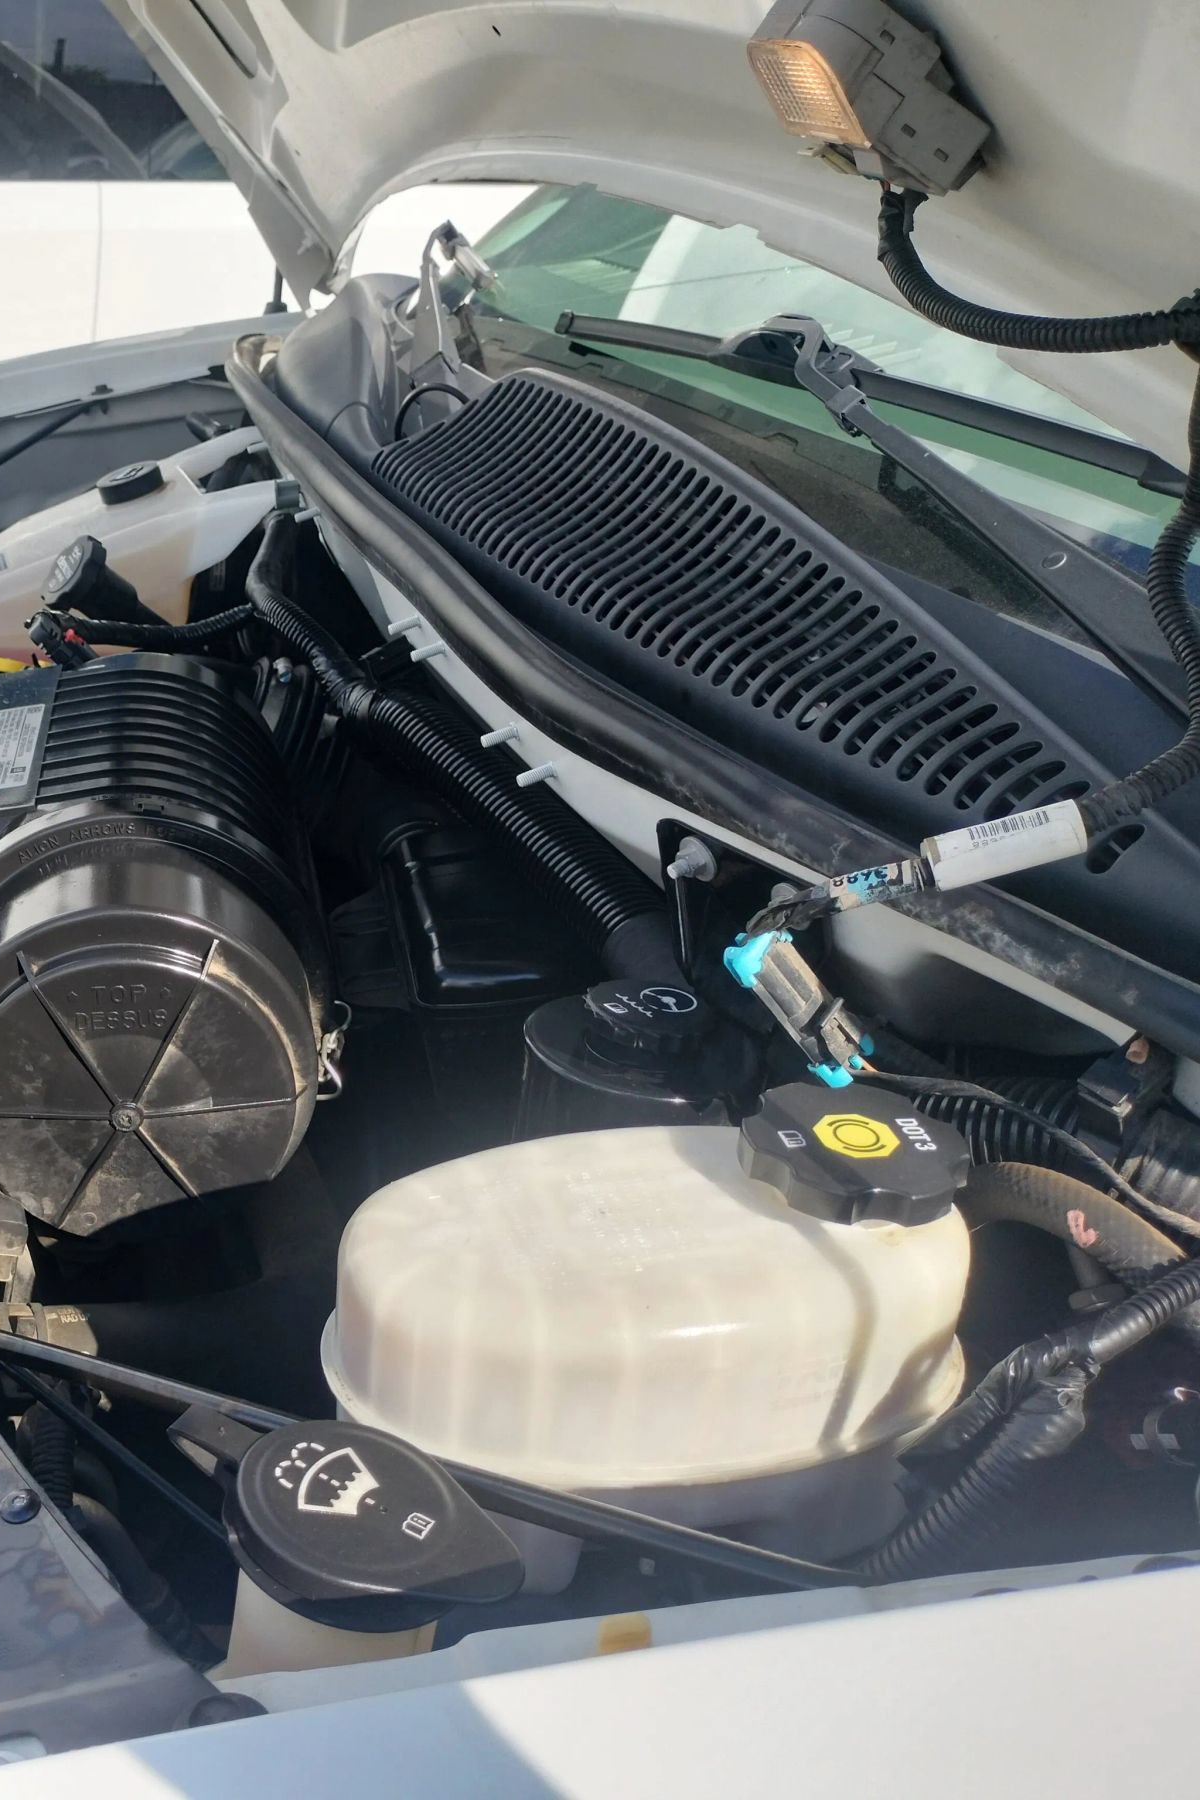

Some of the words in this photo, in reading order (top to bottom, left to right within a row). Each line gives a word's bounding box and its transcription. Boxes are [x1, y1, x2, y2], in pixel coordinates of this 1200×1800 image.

[68, 822, 137, 843] ARROWS
[91, 984, 147, 1004] TOP
[75, 1008, 168, 1030] DESSUS
[894, 1118, 932, 1141] DOT
[914, 1142, 937, 1151] 3
